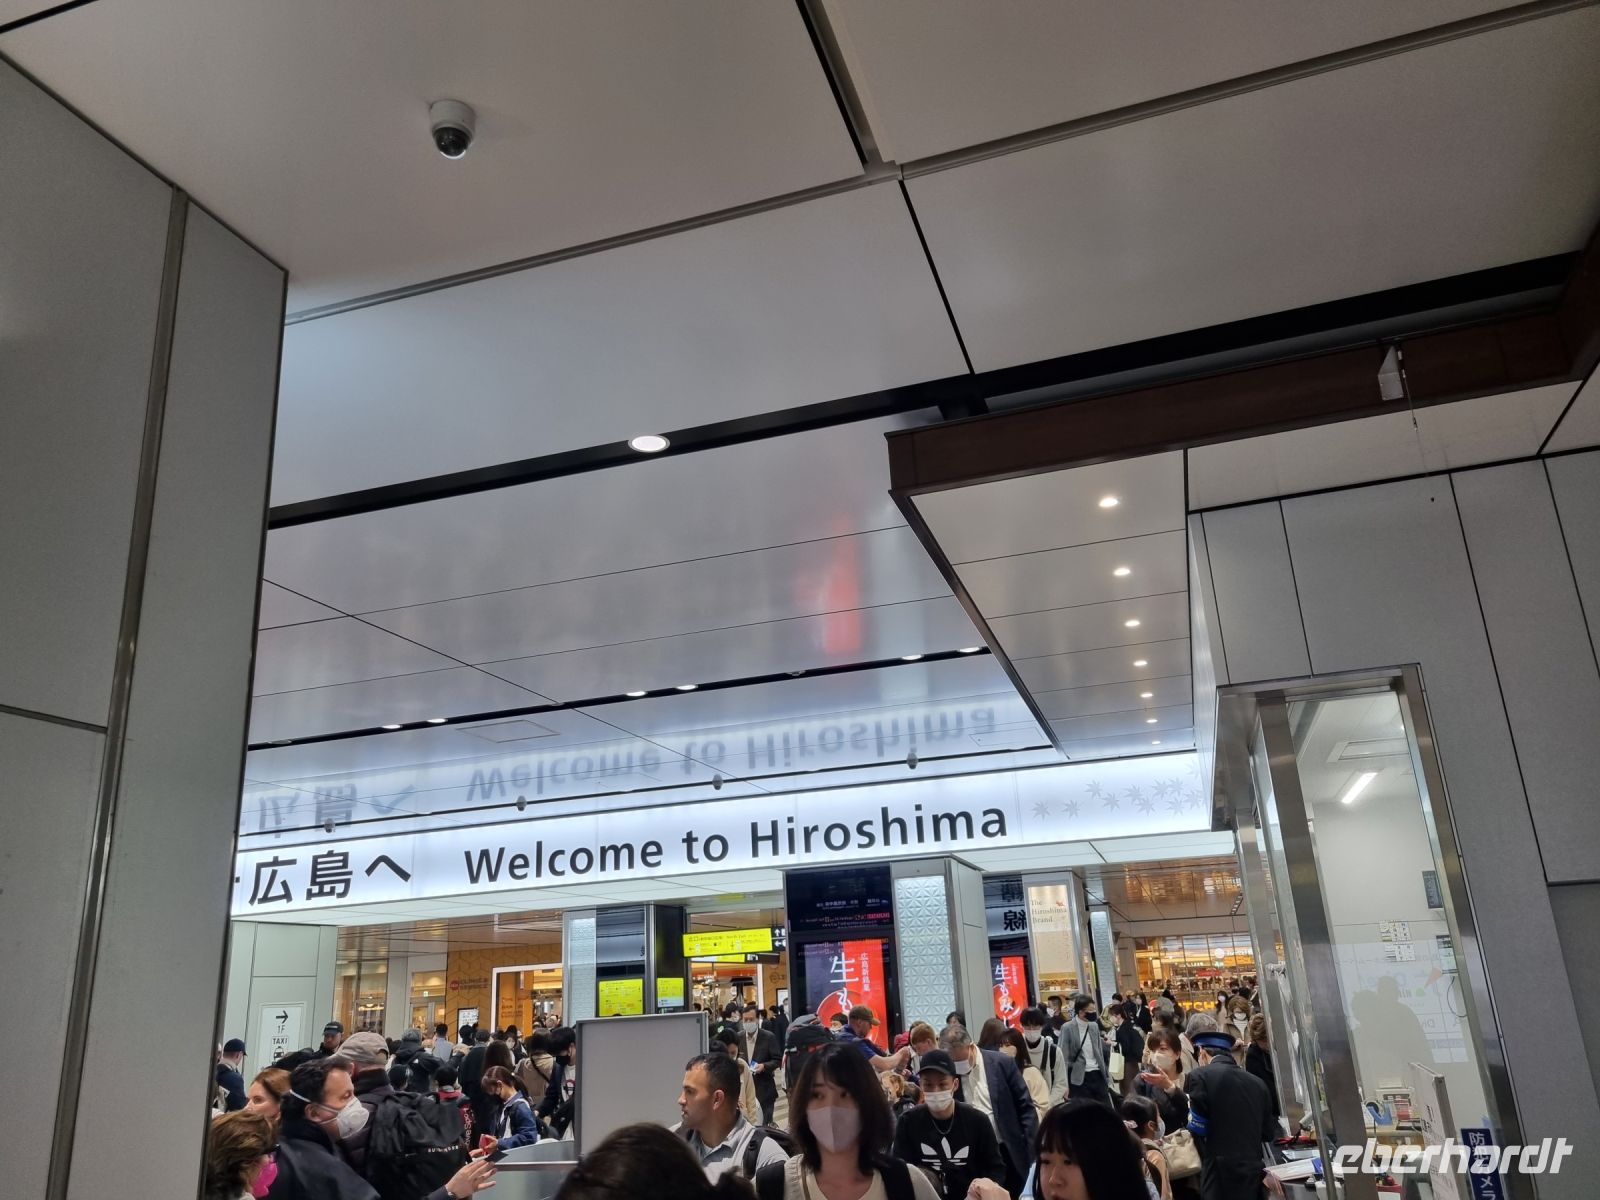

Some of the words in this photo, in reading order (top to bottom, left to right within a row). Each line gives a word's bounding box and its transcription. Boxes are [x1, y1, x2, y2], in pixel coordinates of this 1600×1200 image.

[464, 839, 663, 885] Welcome
[681, 830, 729, 864] to
[751, 803, 1007, 858] Hiroshima
[234, 850, 411, 907] 広島へ
[1032, 907, 1067, 915] Hiroshima
[1032, 916, 1053, 924] Brand
[277, 1024, 286, 1034] 1F
[272, 1037, 288, 1045] TAXI
